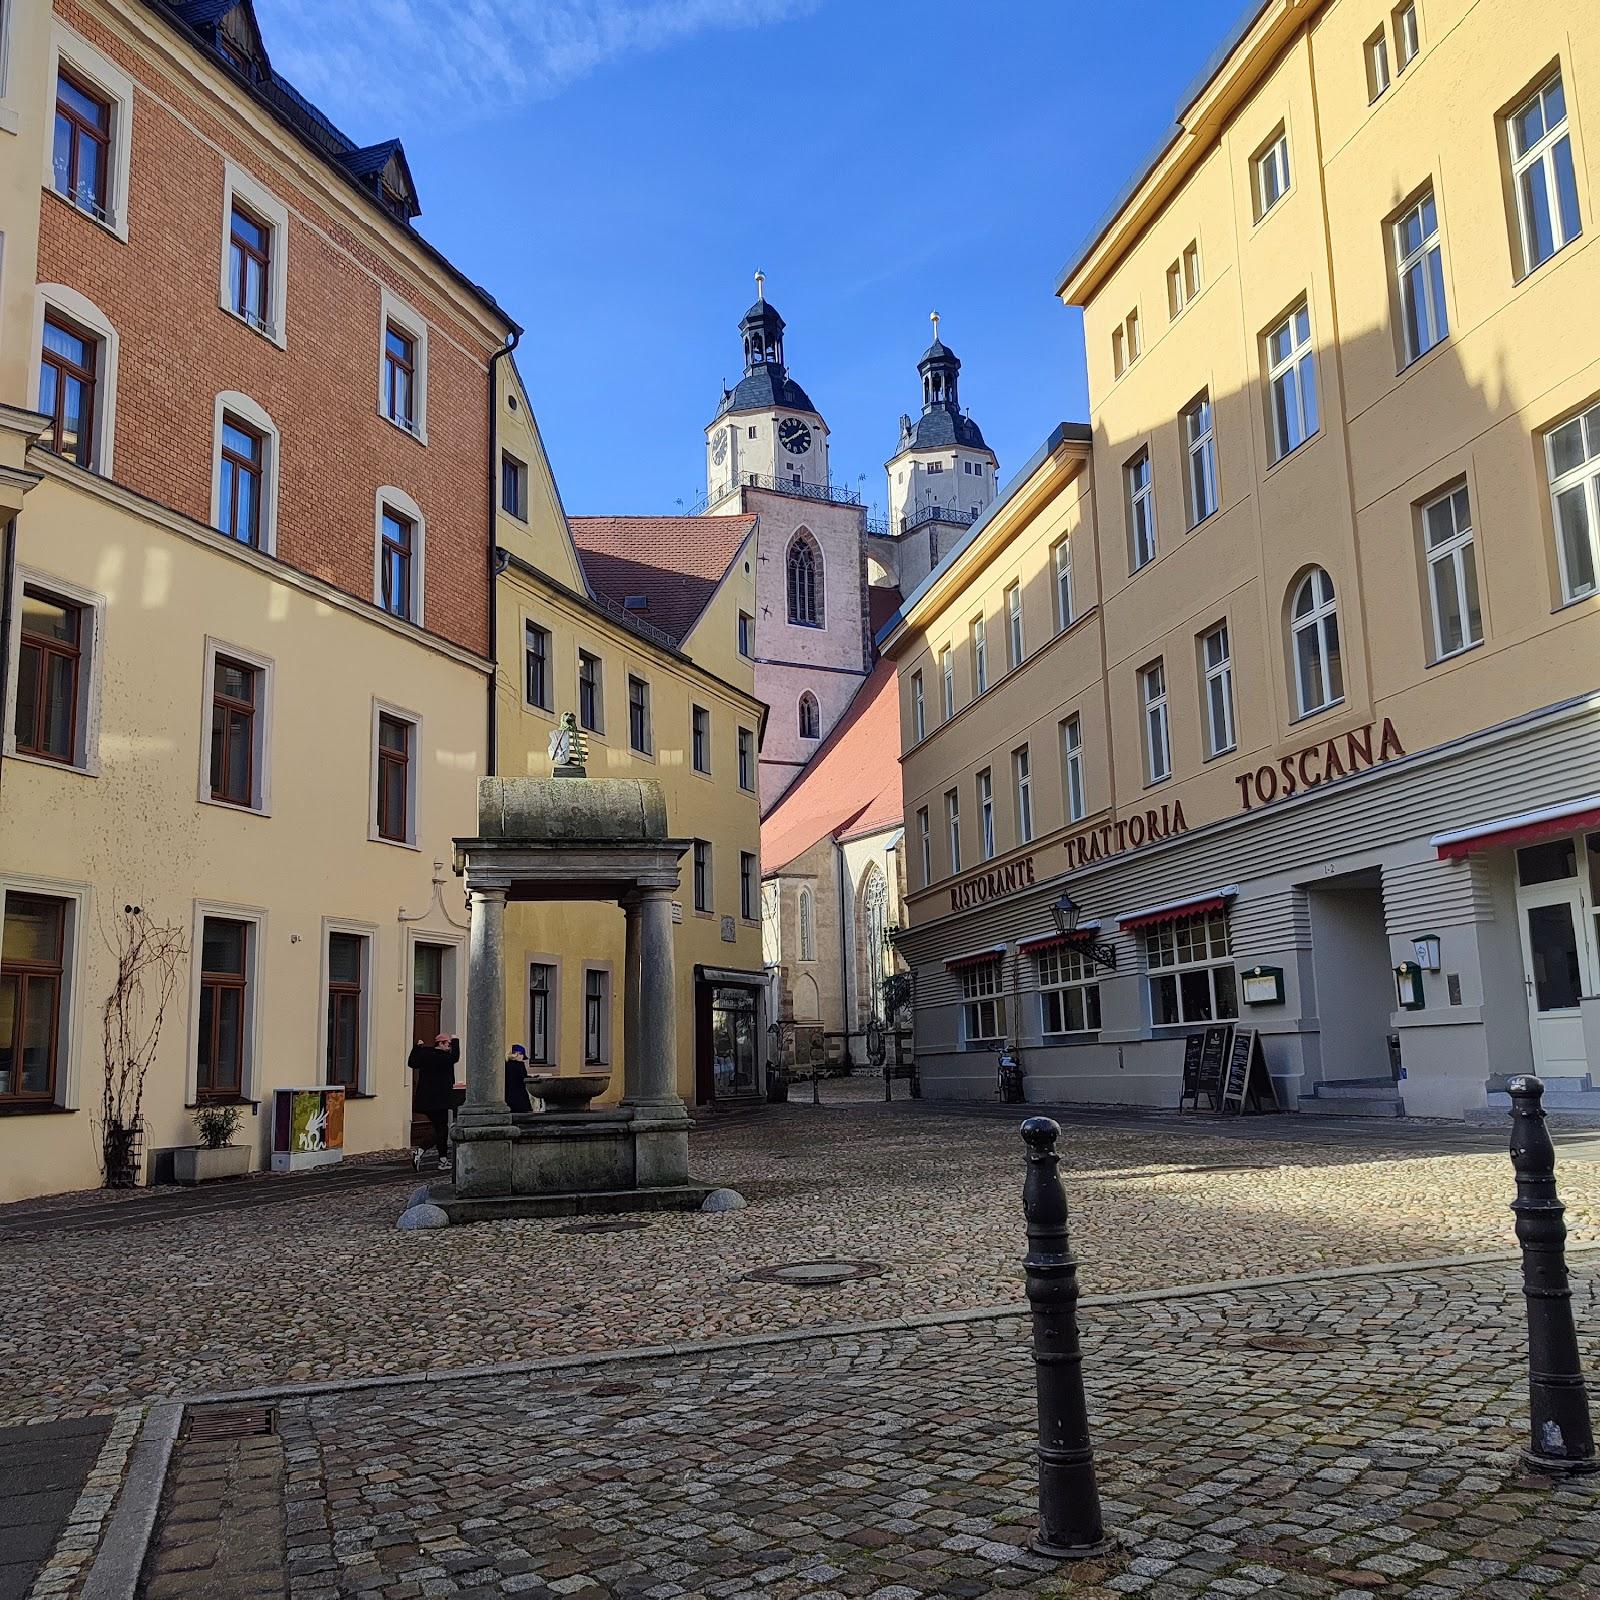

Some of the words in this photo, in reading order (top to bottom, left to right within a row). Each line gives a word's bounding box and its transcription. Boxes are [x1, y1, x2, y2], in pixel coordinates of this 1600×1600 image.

[951, 857, 1035, 911] RISTORANTE
[1064, 799, 1188, 869] TRATTORIA
[1235, 717, 1406, 809] TOSCANA
